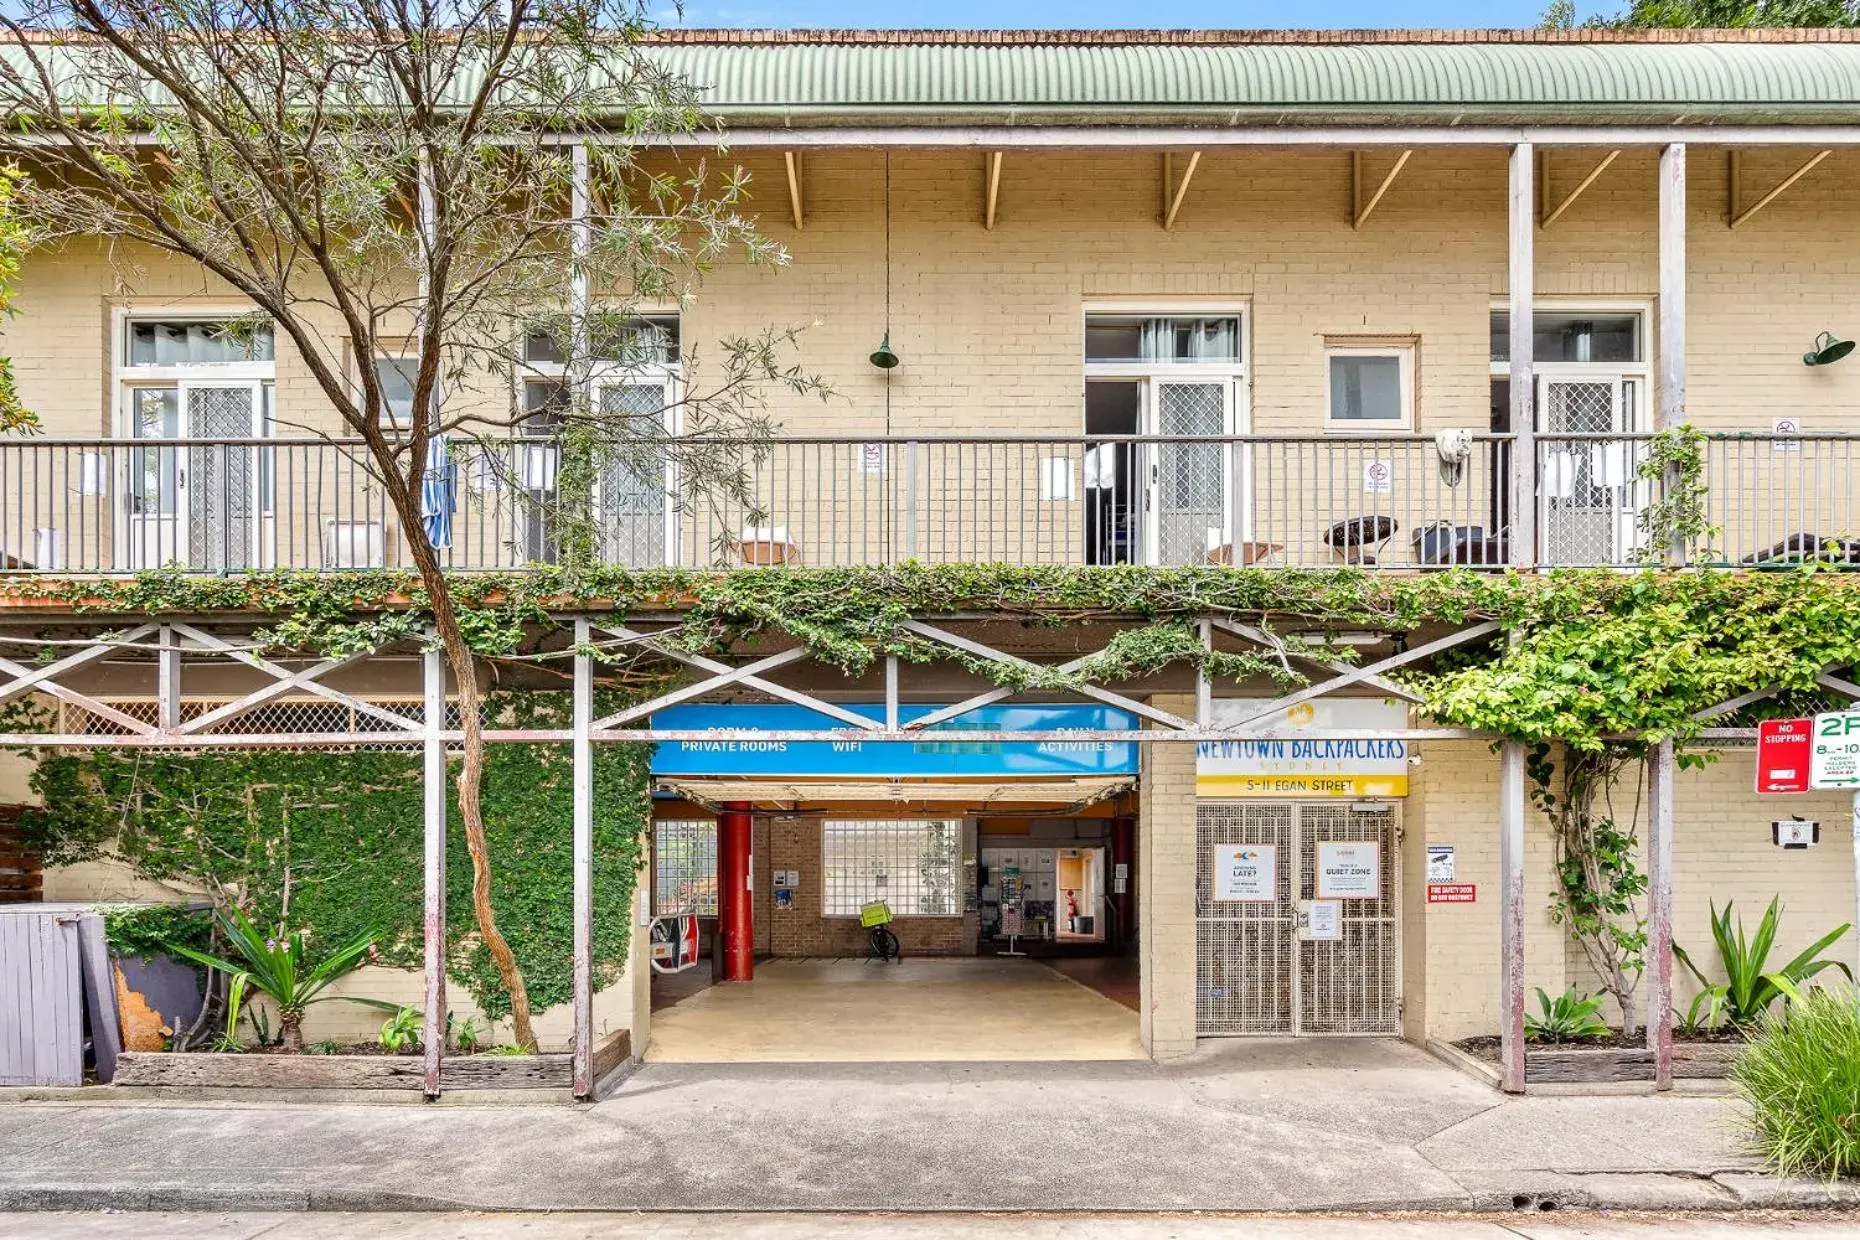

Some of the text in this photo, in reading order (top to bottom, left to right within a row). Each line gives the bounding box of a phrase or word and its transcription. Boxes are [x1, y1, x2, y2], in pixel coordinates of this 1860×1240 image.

[1778, 724, 1794, 733] NO
[1765, 734, 1807, 744] STOPPING
[681, 741, 787, 752] PRIVATE ROOMS
[832, 741, 862, 753] WIFI
[1037, 741, 1112, 753] ACTIVITIES
[1196, 740, 1405, 759] NEWTOWN BACKPACKERS
[1275, 780, 1307, 791] EGAN
[1312, 779, 1353, 791] STREET
[1233, 870, 1257, 878] LATE?
[1326, 868, 1372, 876] QUIET ZONE
